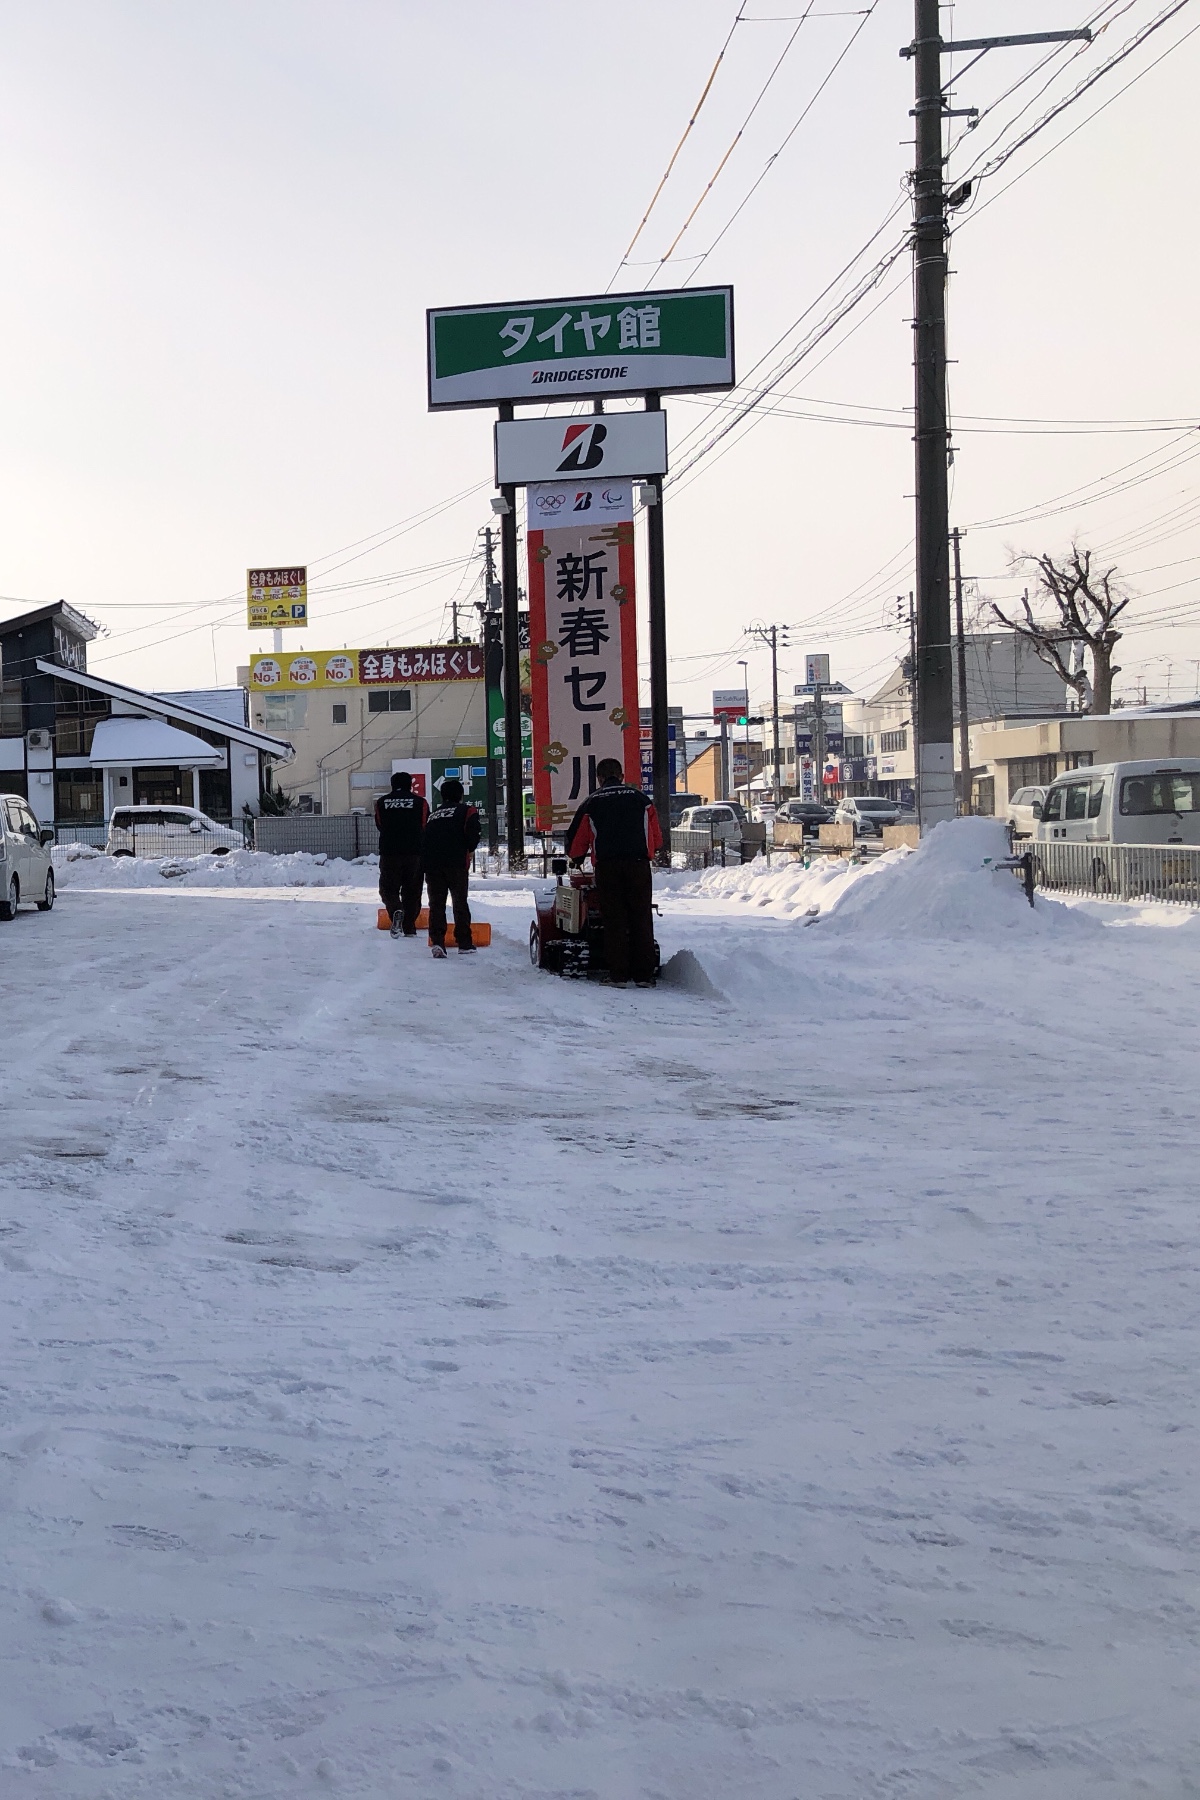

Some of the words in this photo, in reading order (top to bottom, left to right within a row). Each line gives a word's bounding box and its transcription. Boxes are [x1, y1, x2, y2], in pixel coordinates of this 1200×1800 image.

[499, 305, 661, 358] タイヤ館
[531, 366, 628, 385] BRIDGESTONE
[250, 570, 304, 587] 全身もみほぐし
[294, 605, 303, 618] P
[363, 650, 481, 680] 全身もみほぐし
[253, 671, 281, 683] No.1
[289, 670, 317, 681] No.1
[325, 668, 354, 680] No.1
[556, 550, 610, 800] 新春セール
[803, 771, 812, 794] 公明党
[384, 802, 414, 810] VRX2
